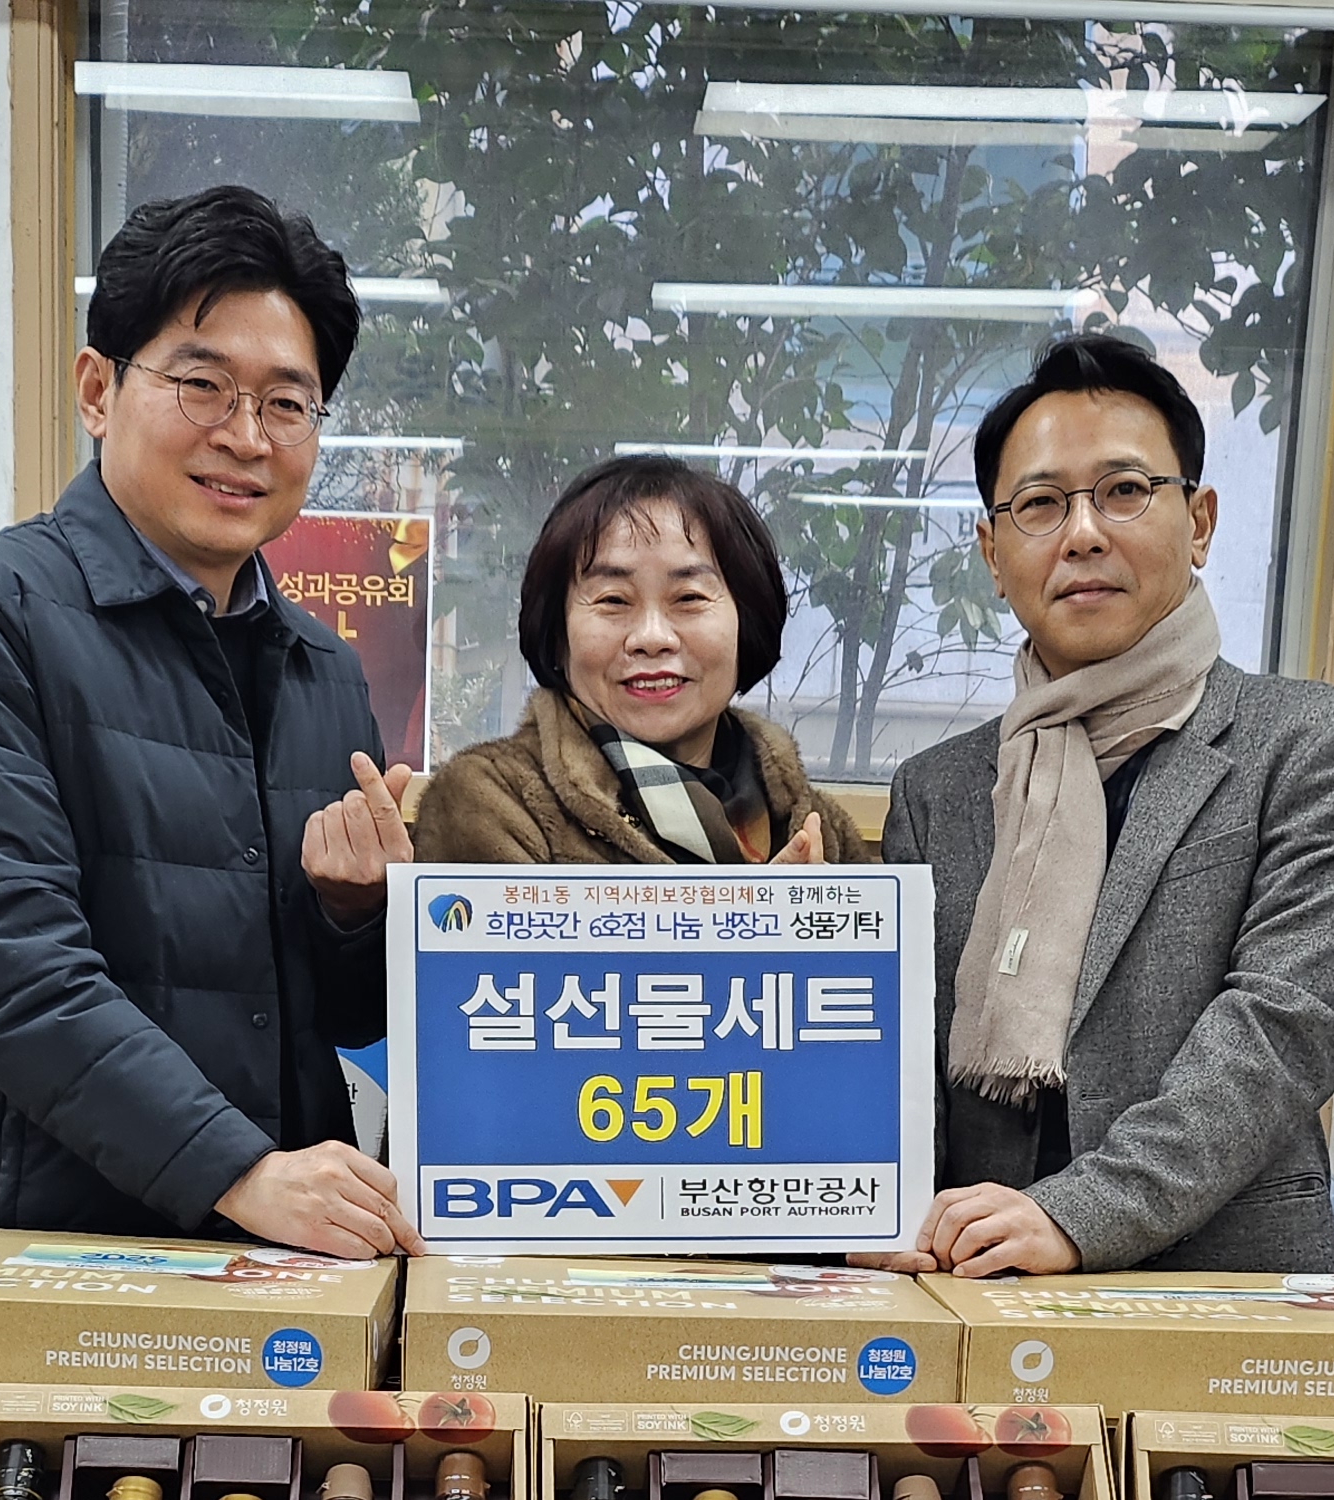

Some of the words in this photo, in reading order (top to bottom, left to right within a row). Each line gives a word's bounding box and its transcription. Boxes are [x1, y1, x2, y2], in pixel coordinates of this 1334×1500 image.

[277, 571, 414, 607] 성과공유회
[503, 885, 572, 905] 봉래1동
[584, 885, 775, 906] 지역사회보장협의체와
[787, 885, 862, 905] 함께하는
[485, 911, 582, 941] 희망곳간
[589, 913, 646, 941] 6호점
[656, 911, 703, 941] 나눔
[712, 912, 782, 941] 냉장고
[789, 911, 883, 941] 성품기탁
[459, 972, 882, 1053] 설선물세트
[577, 1071, 763, 1150] 65개
[432, 1178, 616, 1219] BPA
[679, 1177, 881, 1204] 부산항만공사
[681, 1207, 735, 1218] BUSAN
[740, 1207, 781, 1218] PORT
[787, 1206, 876, 1217] AUTHORITY
[78, 1331, 252, 1355] CHUNGJUNGONE
[272, 1339, 313, 1356] 청정원
[678, 1342, 847, 1364] CHUNGJUNGONE
[45, 1349, 139, 1370] PREMIUM
[143, 1353, 252, 1375] SELECTION
[264, 1354, 320, 1374] 나눔12호
[867, 1347, 907, 1364] 청정원
[646, 1364, 736, 1382] PREMIUM
[742, 1365, 847, 1383] SELECTION
[52, 1402, 78, 1411] SOY
[80, 1402, 103, 1412] INK
[235, 1397, 288, 1417] 청정원
